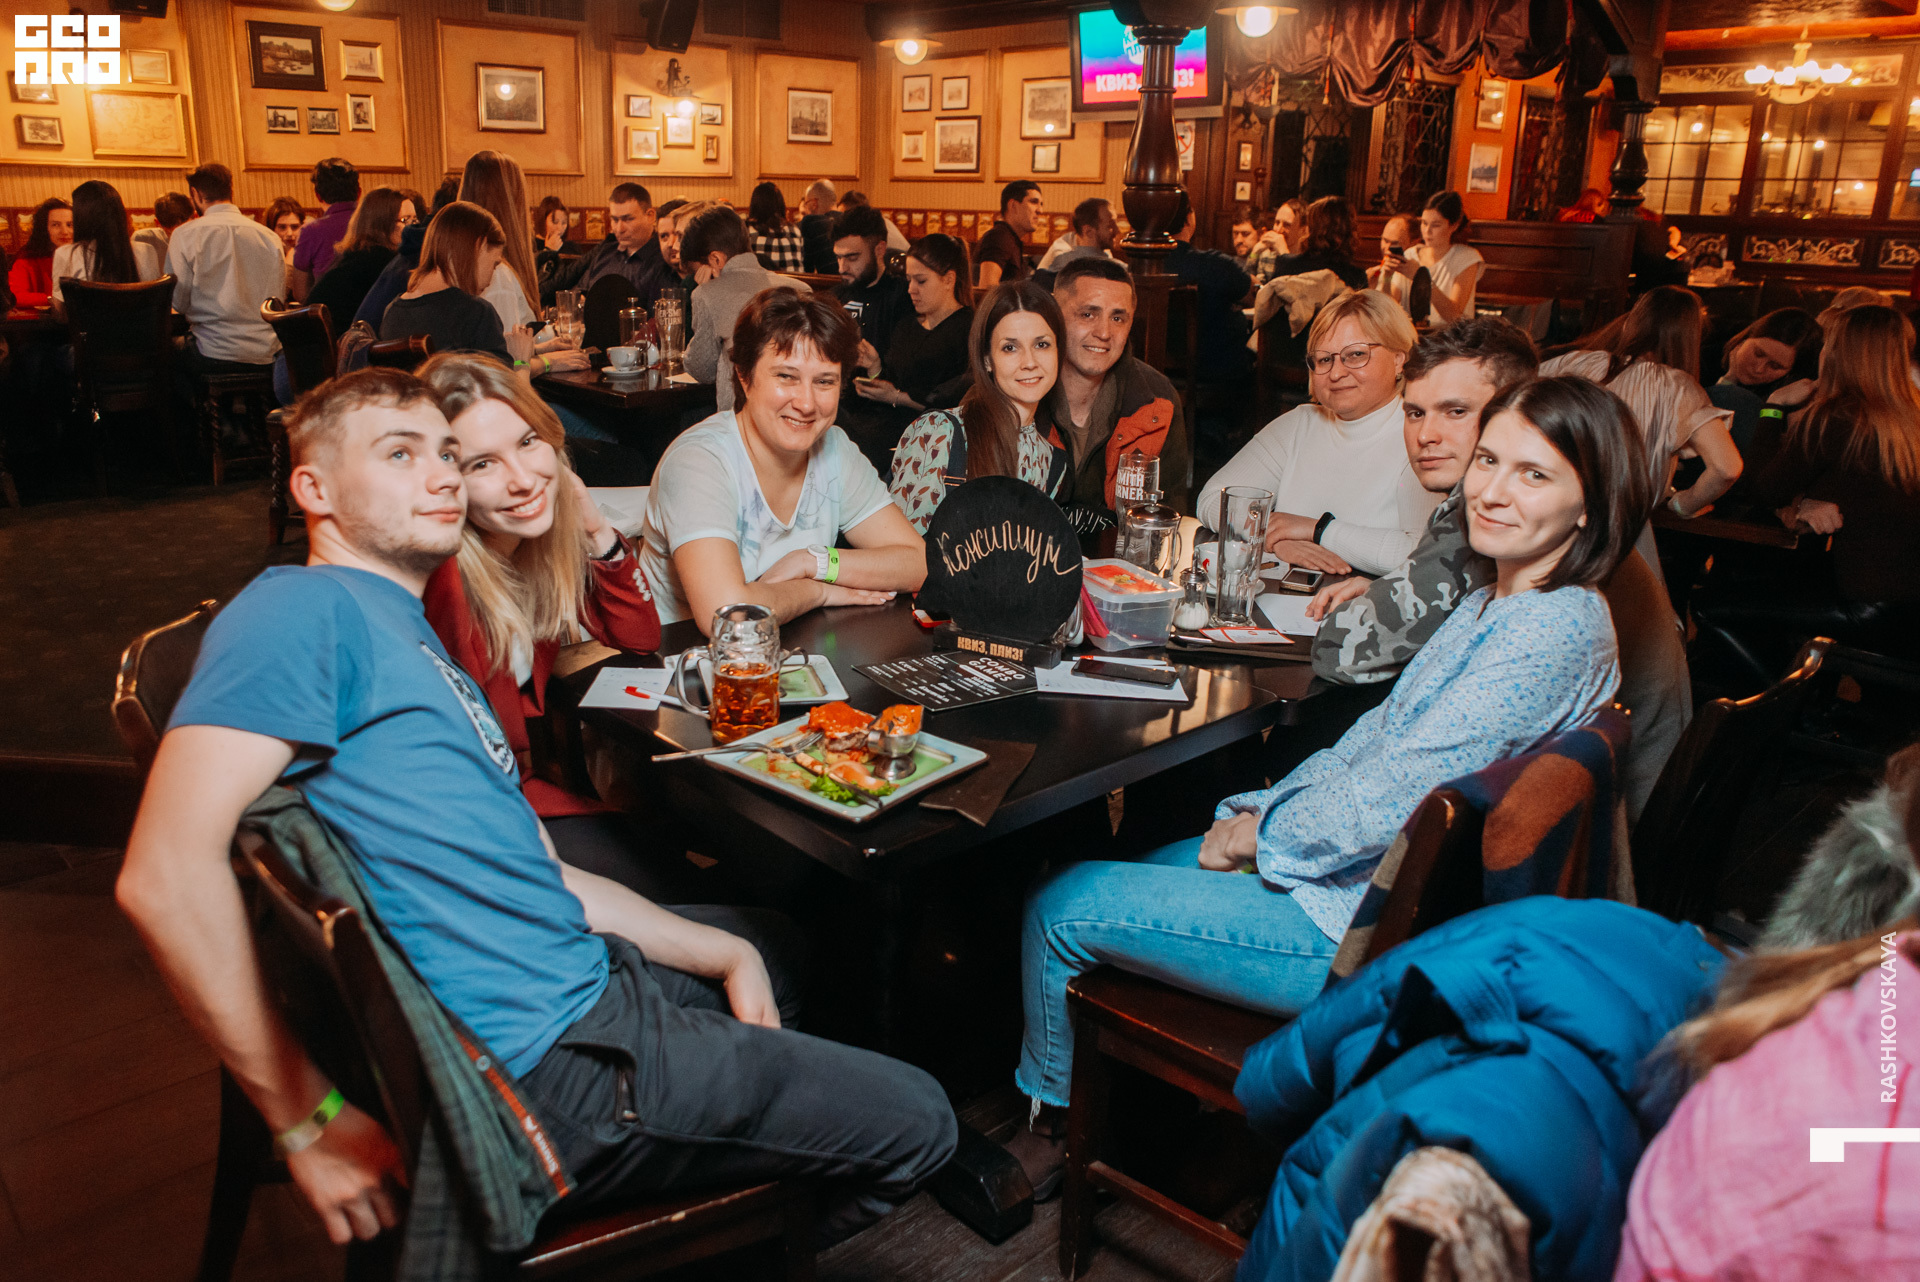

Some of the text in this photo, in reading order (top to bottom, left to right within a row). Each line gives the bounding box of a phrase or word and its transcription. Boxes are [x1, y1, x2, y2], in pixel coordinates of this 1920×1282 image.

[957, 636, 1024, 661] КВИЗ, ПЛИЗ!
[968, 660, 1012, 682] GAMES
[980, 657, 1026, 680] COMBO
